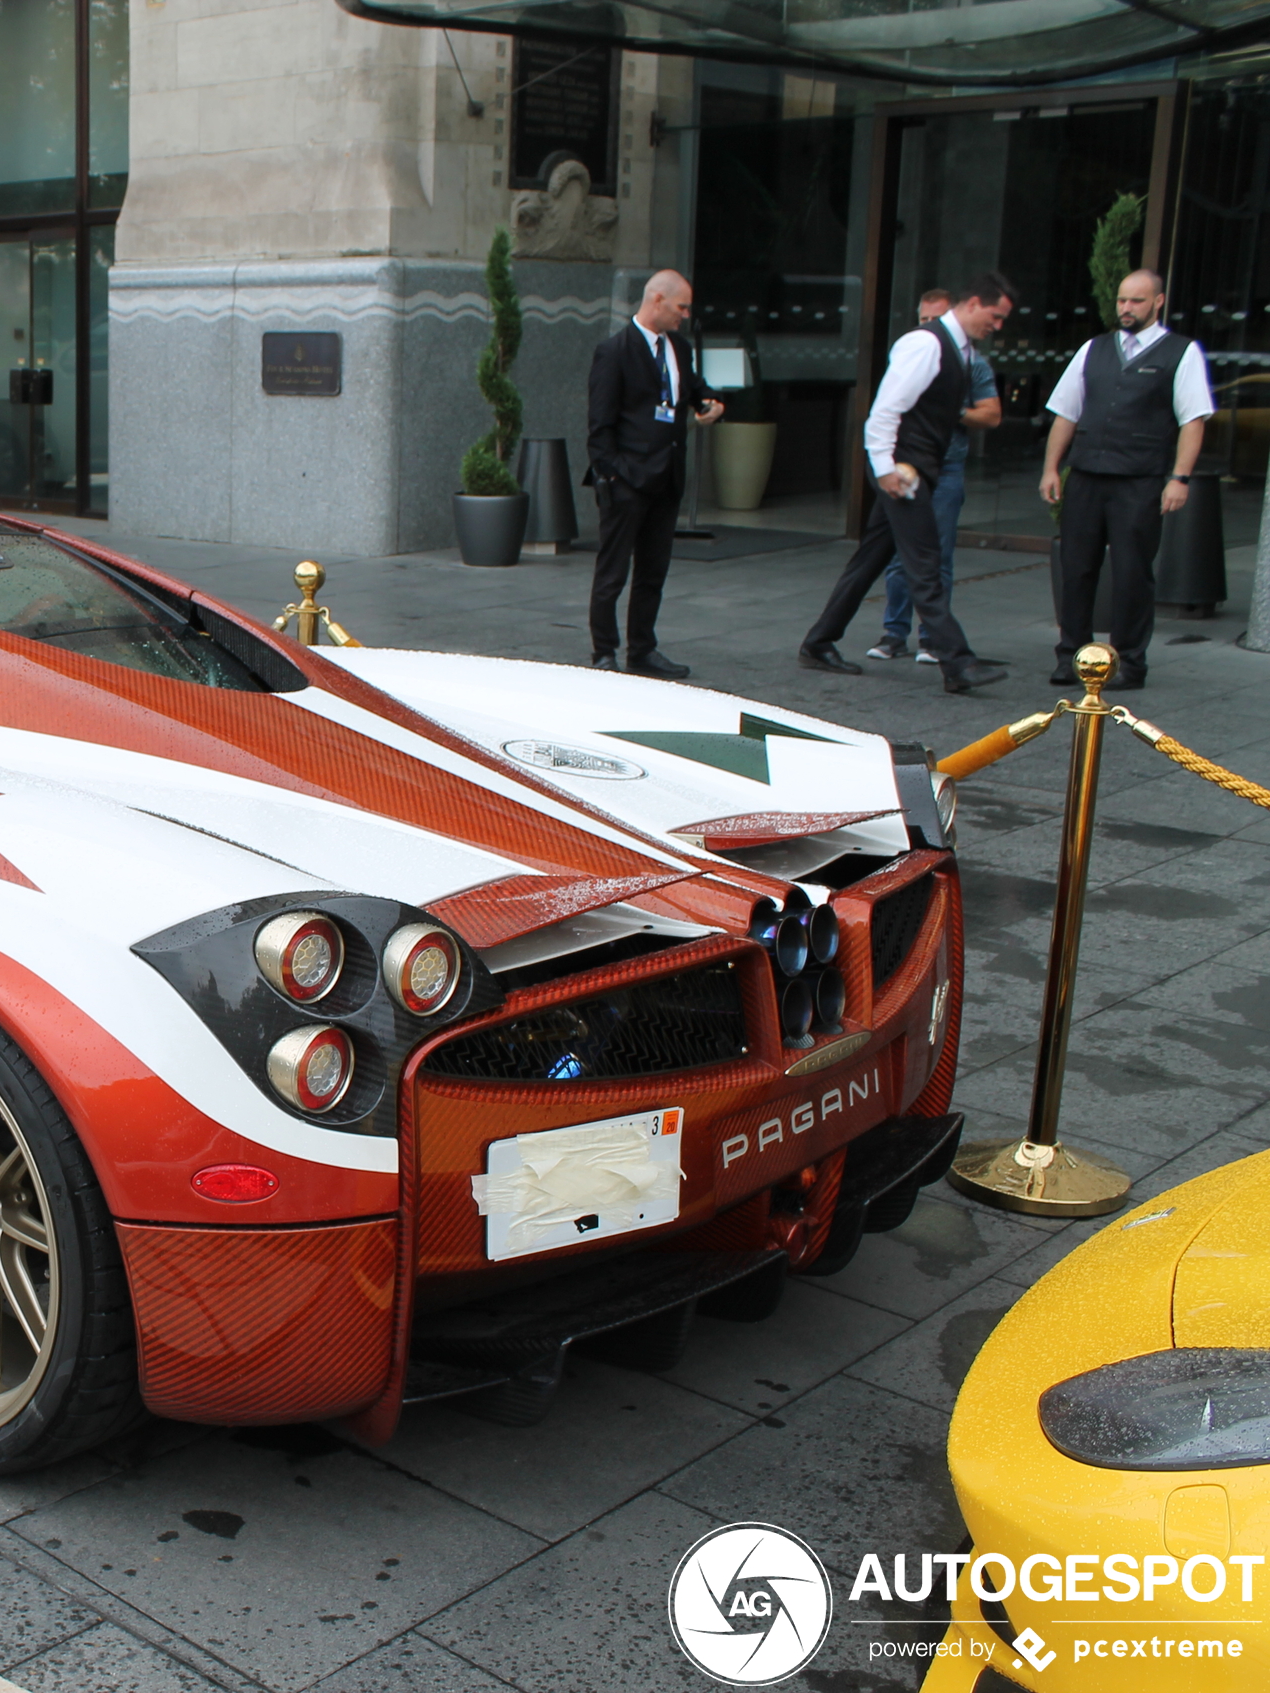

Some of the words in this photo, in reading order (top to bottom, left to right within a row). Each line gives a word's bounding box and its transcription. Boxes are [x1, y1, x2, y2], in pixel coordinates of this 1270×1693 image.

[651, 1116, 660, 1136] 3
[666, 1121, 676, 1133] 20
[722, 1068, 879, 1169] PAGANI
